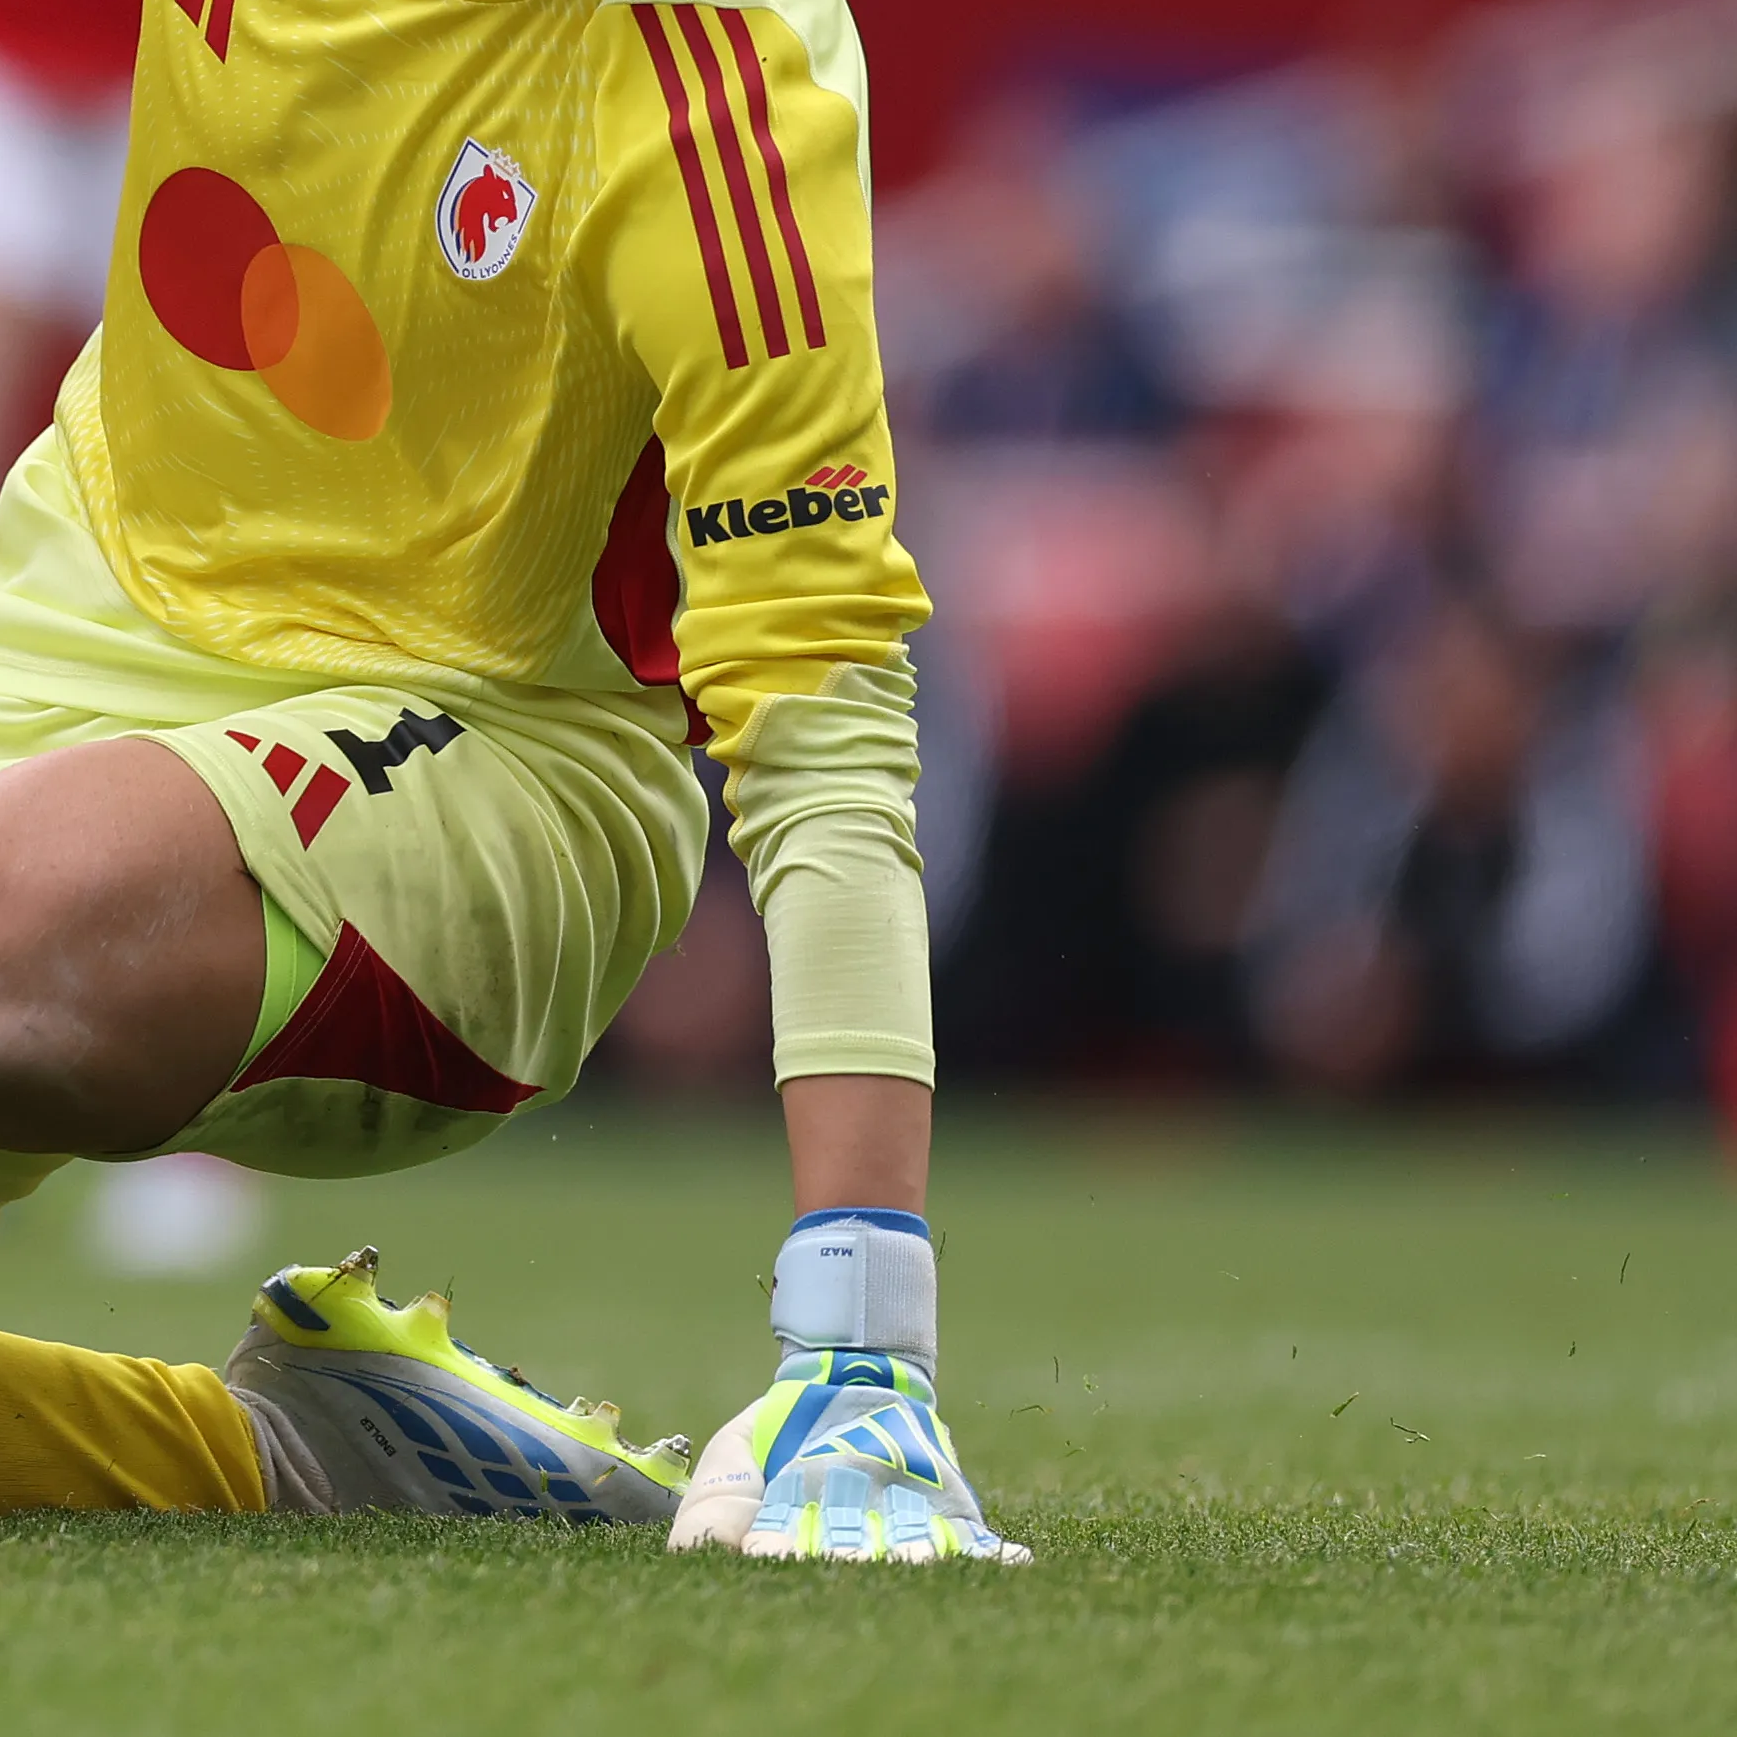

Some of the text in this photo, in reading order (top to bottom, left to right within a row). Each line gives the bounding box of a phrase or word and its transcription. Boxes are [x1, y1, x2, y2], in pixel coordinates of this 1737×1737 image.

[461, 233, 518, 279] OL LYONNES
[685, 483, 890, 548] Kleber
[820, 1247, 853, 1257] MAZI
[359, 1415, 397, 1458] ENDLER
